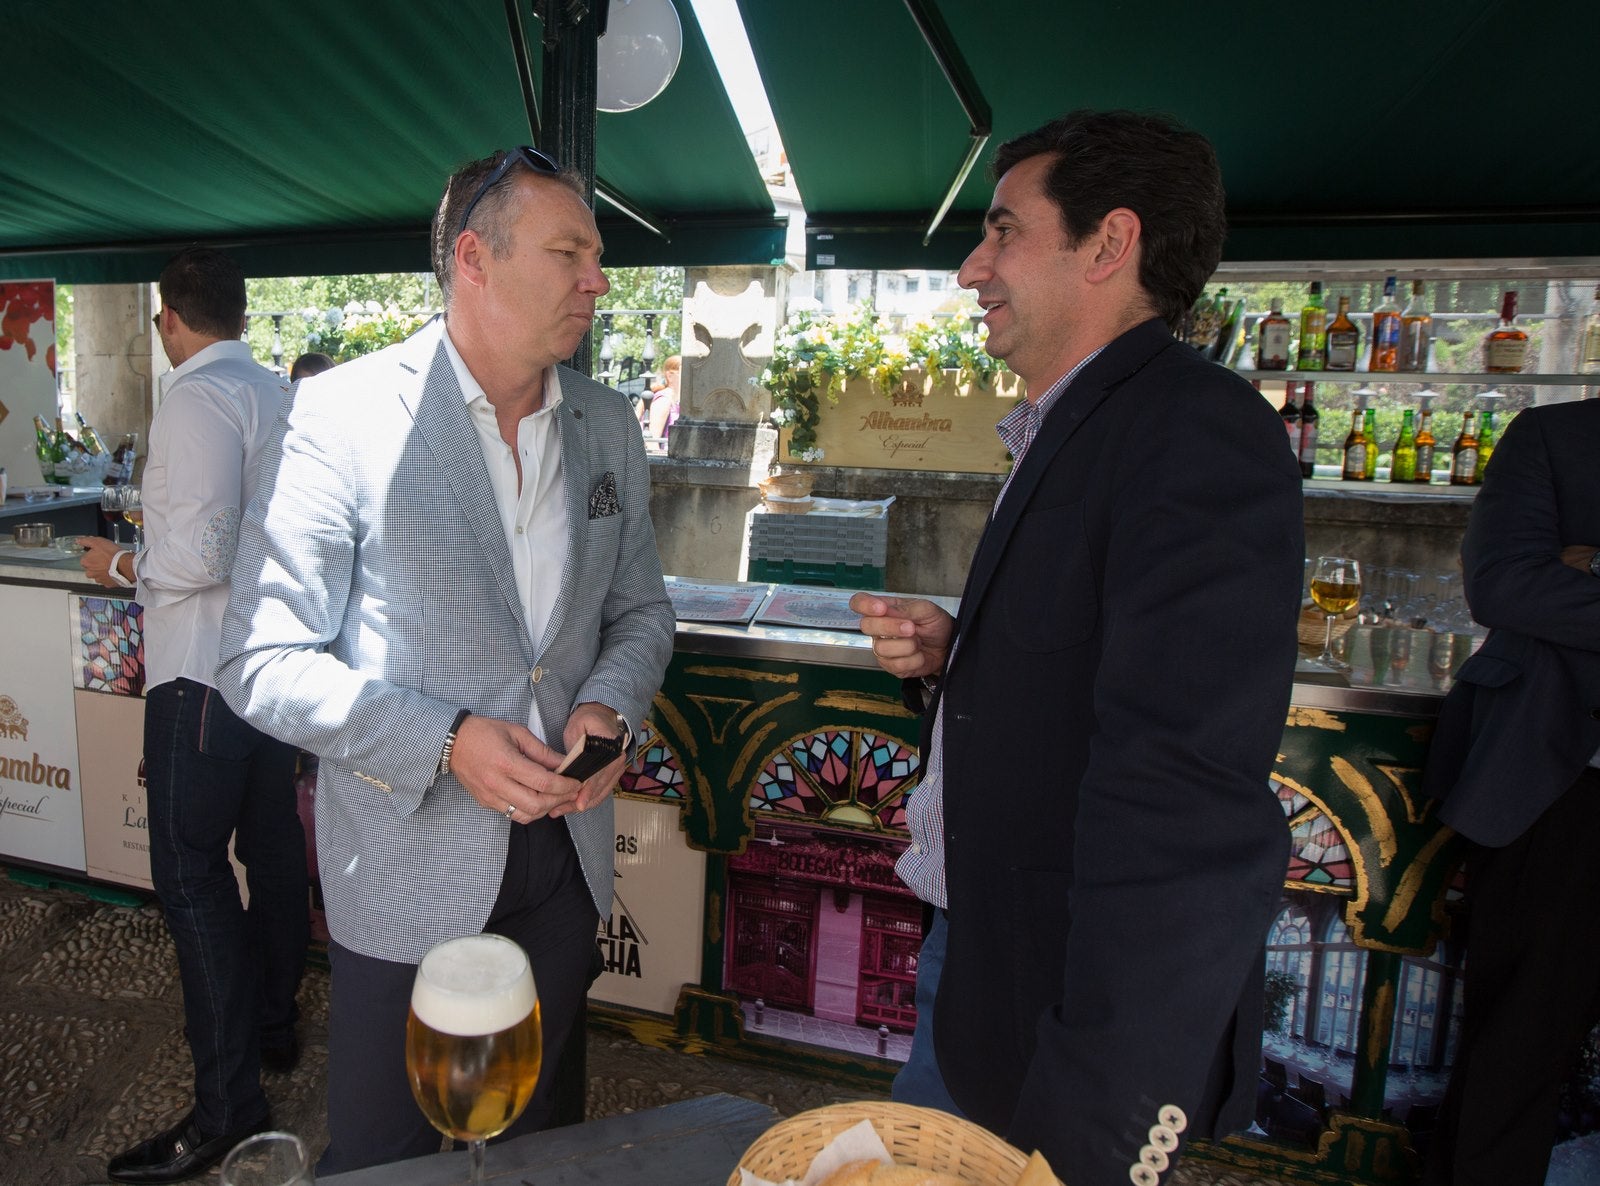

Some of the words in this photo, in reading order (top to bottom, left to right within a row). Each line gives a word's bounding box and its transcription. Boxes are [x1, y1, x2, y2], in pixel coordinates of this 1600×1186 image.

[859, 410, 953, 433] Alhambra
[879, 434, 934, 459] Especial
[0, 752, 71, 791] ambra
[0, 795, 50, 818] pecial
[615, 834, 638, 855] as
